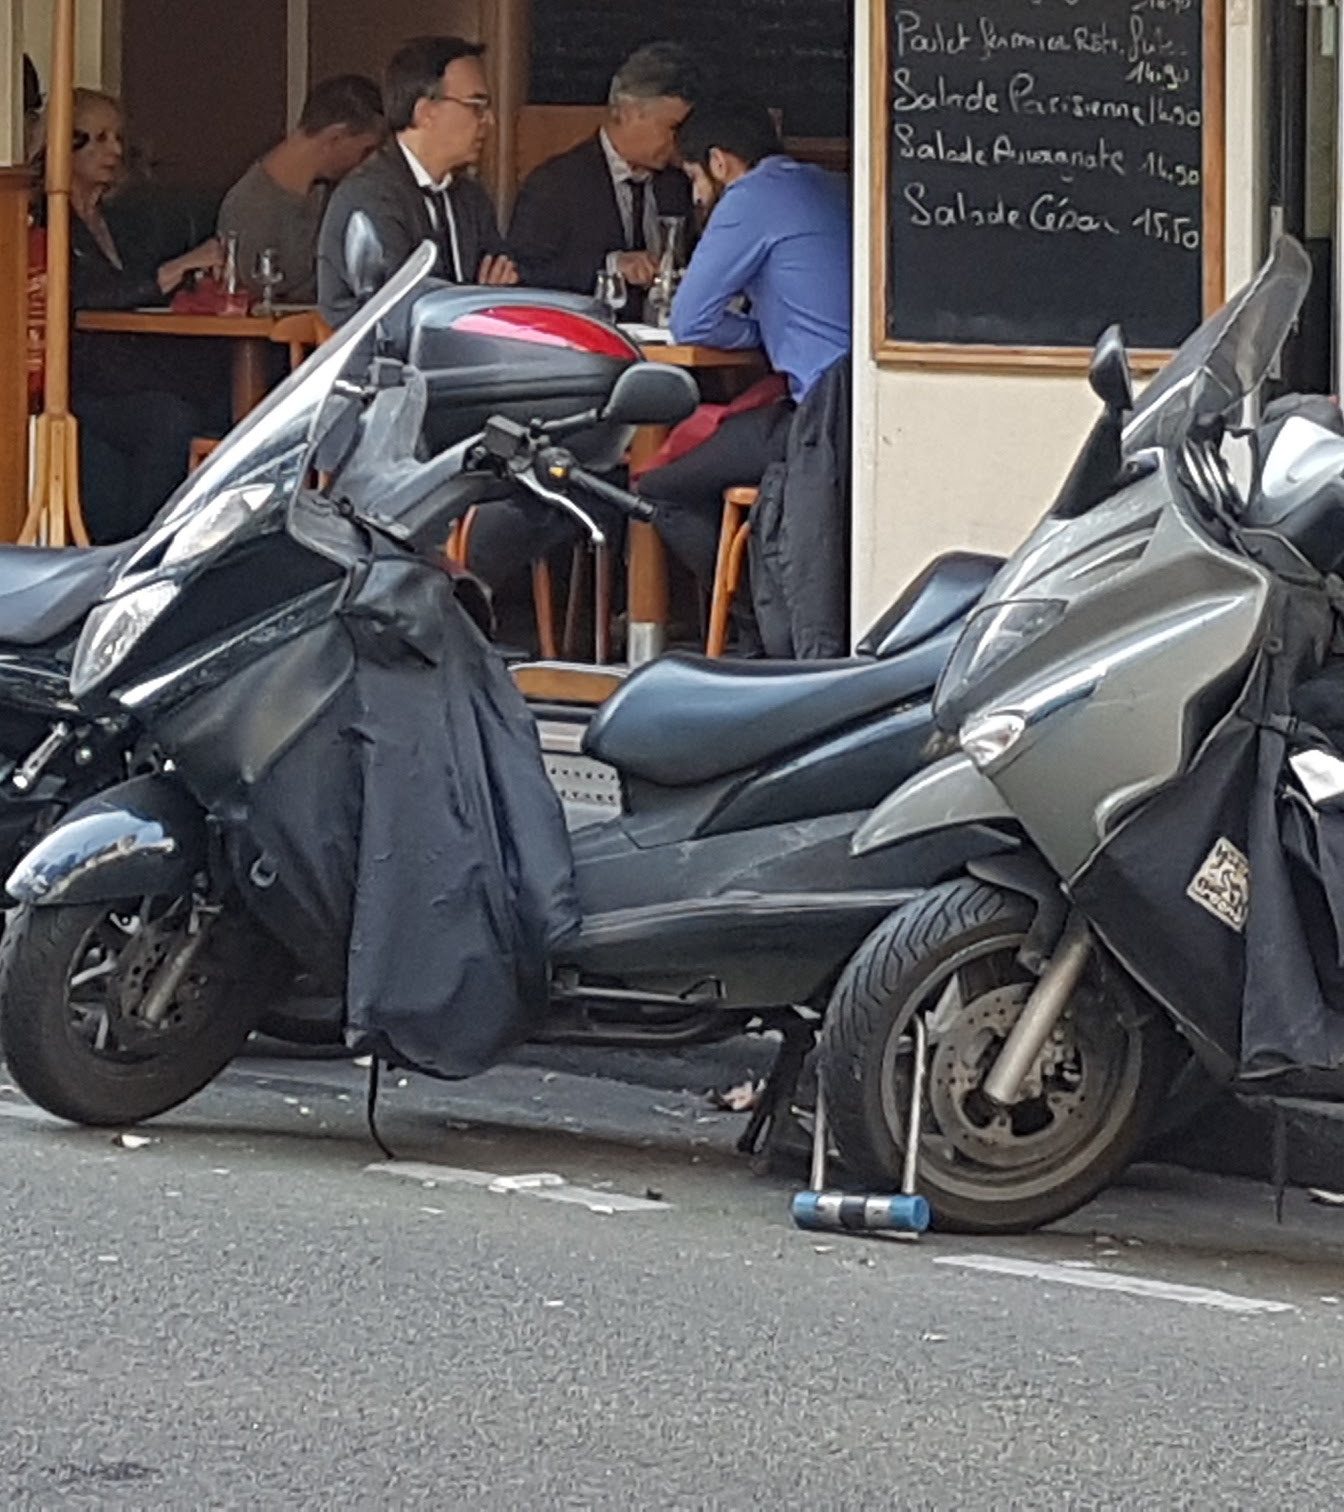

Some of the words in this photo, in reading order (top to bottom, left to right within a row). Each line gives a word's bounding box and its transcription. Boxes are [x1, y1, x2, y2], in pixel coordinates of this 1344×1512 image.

[894, 68, 999, 113] Salade
[1010, 72, 1145, 126] Parisienne
[895, 124, 989, 167] Salade
[904, 183, 1022, 230] Salade
